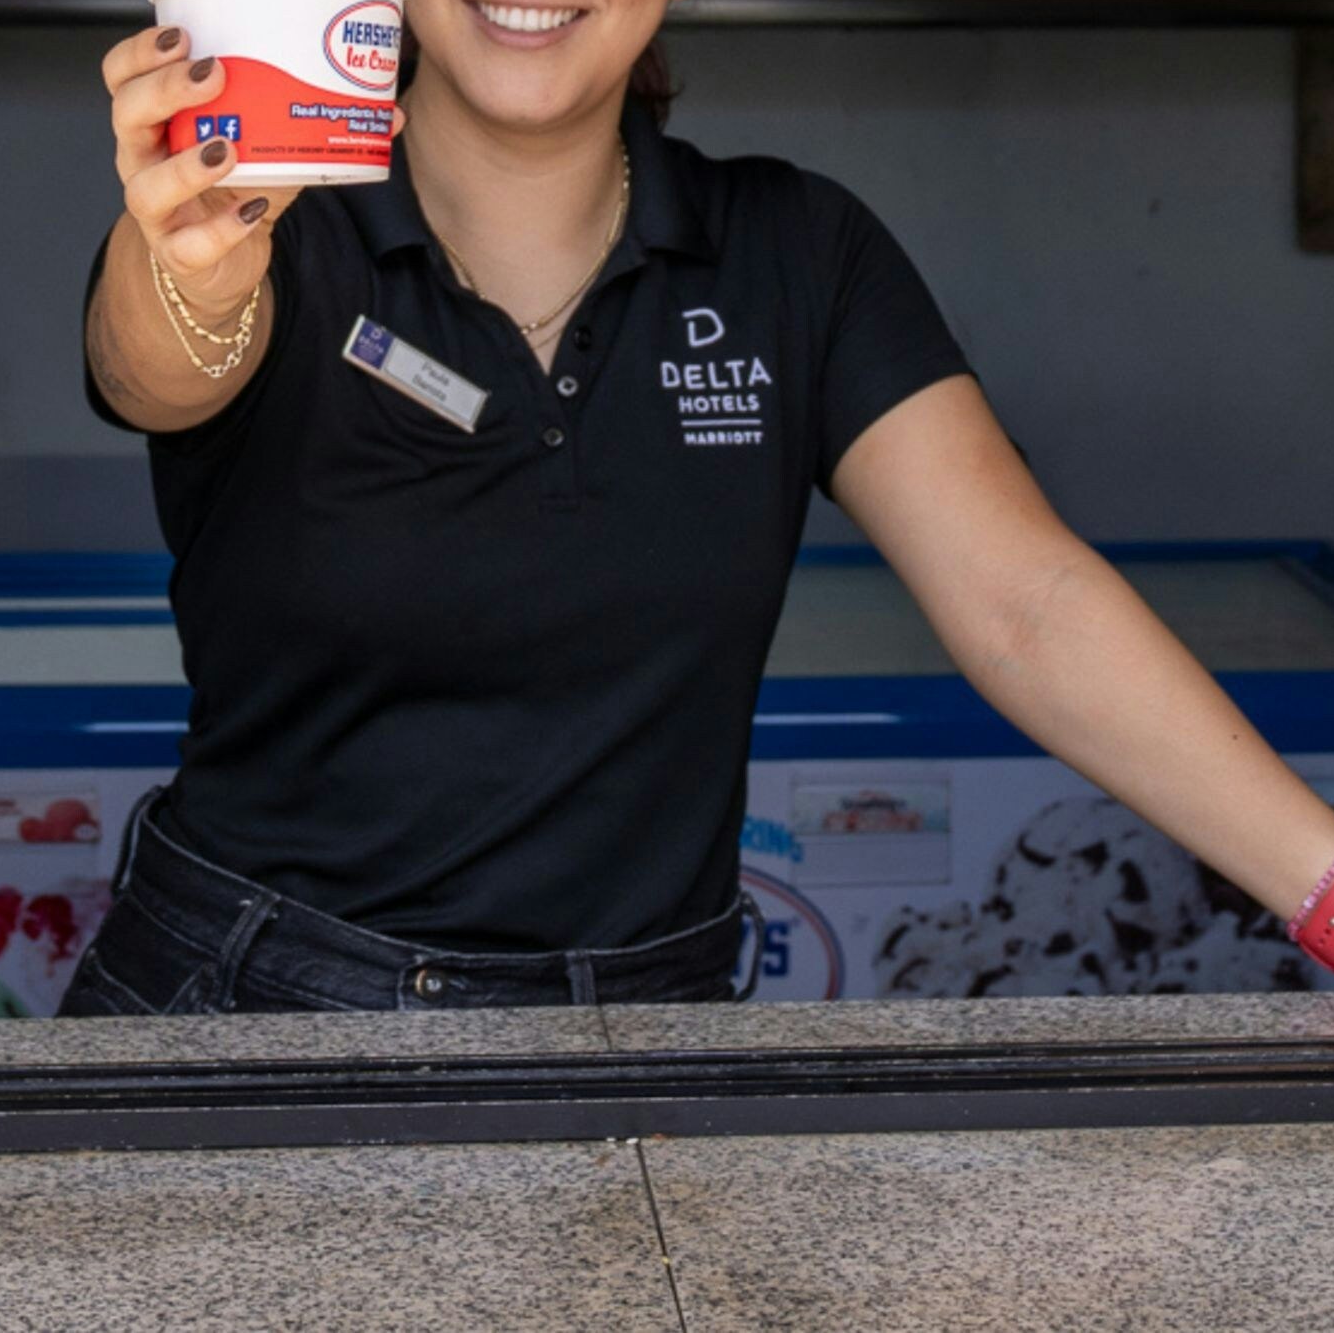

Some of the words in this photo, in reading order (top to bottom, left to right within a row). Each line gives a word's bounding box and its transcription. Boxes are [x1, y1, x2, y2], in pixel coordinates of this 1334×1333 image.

[660, 357, 772, 389] DELTA
[678, 394, 760, 413] HOTELS
[684, 431, 763, 444] MARRIOTT
